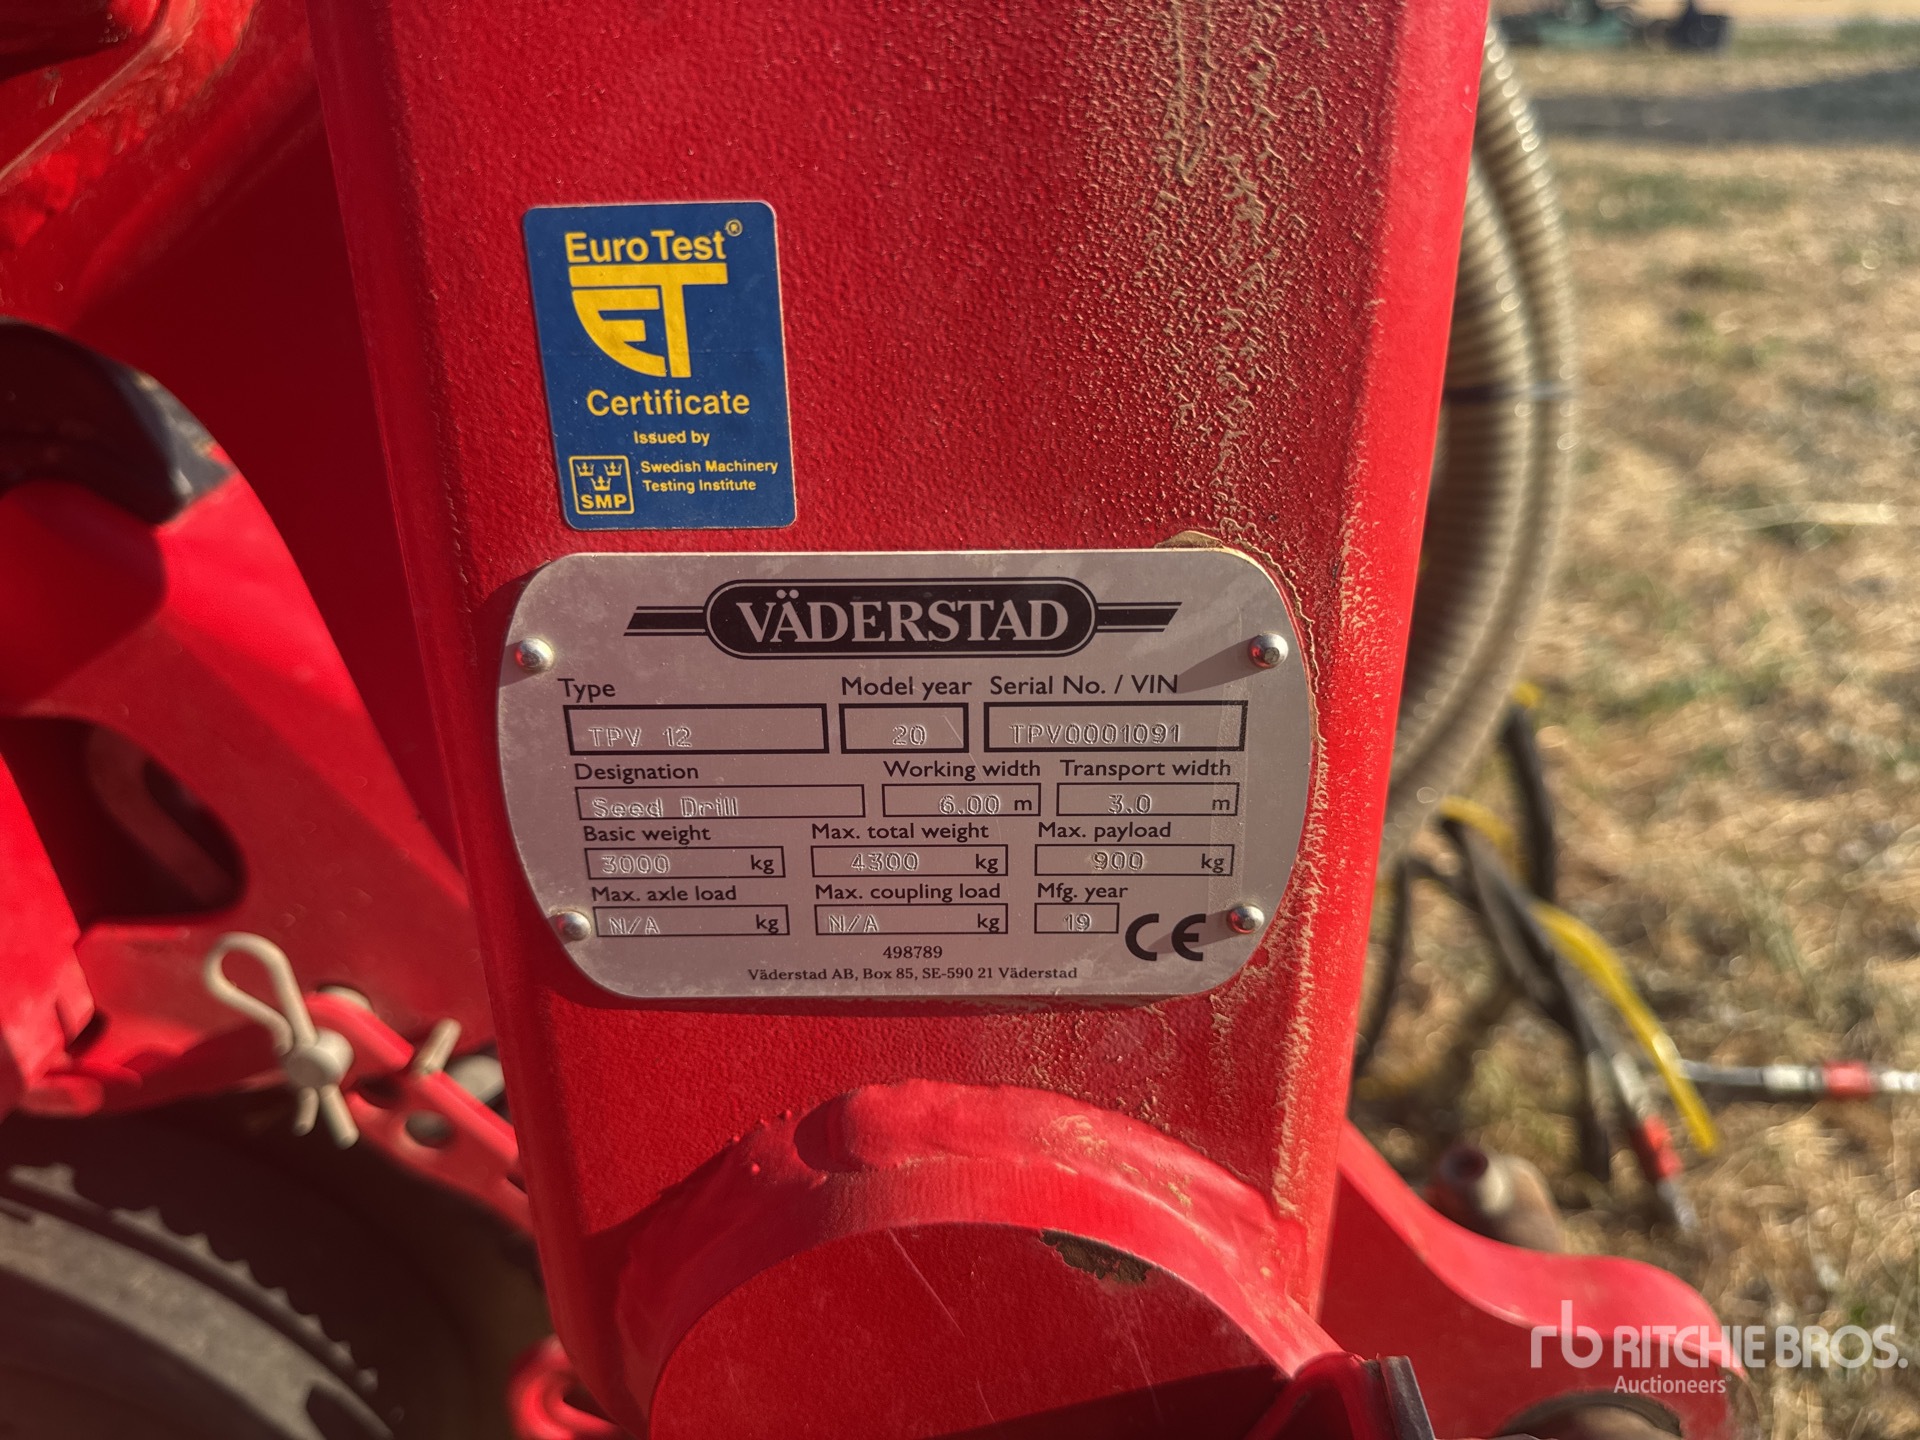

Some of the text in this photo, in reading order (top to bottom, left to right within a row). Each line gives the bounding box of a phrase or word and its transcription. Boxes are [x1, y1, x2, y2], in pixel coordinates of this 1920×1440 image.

[565, 232, 649, 263] Euro
[587, 389, 750, 416] Certificate
[633, 430, 710, 446] Issued by
[640, 460, 778, 475] Swedish Machinery
[643, 479, 756, 494] Testing Institute
[581, 495, 627, 509] SMP
[736, 589, 1069, 643] VÄDERSTAD
[558, 678, 616, 702] Type
[842, 676, 972, 701] Model year
[990, 674, 1178, 695] Serial No. / VIN
[588, 726, 692, 748] TPV 12
[892, 725, 926, 746] 20
[1009, 723, 1181, 745] TPV0001091
[575, 763, 699, 784] Designation
[884, 759, 1040, 781] Working width
[1060, 759, 1231, 778] Transport width
[592, 797, 738, 818] Seed Drill
[939, 794, 1033, 815] 6.00 m
[1108, 794, 1230, 815] 3.0 m
[584, 824, 712, 846] Basic weight
[812, 823, 989, 843] Max. total weight
[1038, 822, 1171, 842] Max. payload
[601, 855, 774, 875] 3000 kg
[851, 852, 999, 873] 4300 kg
[1091, 851, 1225, 873] 900 kg
[592, 885, 737, 902] Max. axle load
[815, 883, 1000, 904] Max. coupling load
[1037, 883, 1128, 902] Mfg. year
[608, 914, 779, 935] N/A kg
[828, 913, 1000, 933] N/A kg
[1063, 913, 1092, 932] 19
[1125, 913, 1207, 962] CE
[882, 946, 943, 959] 498789
[748, 966, 1078, 982] Väderstad AB, Box 85, SE-590 21 Väderstad
